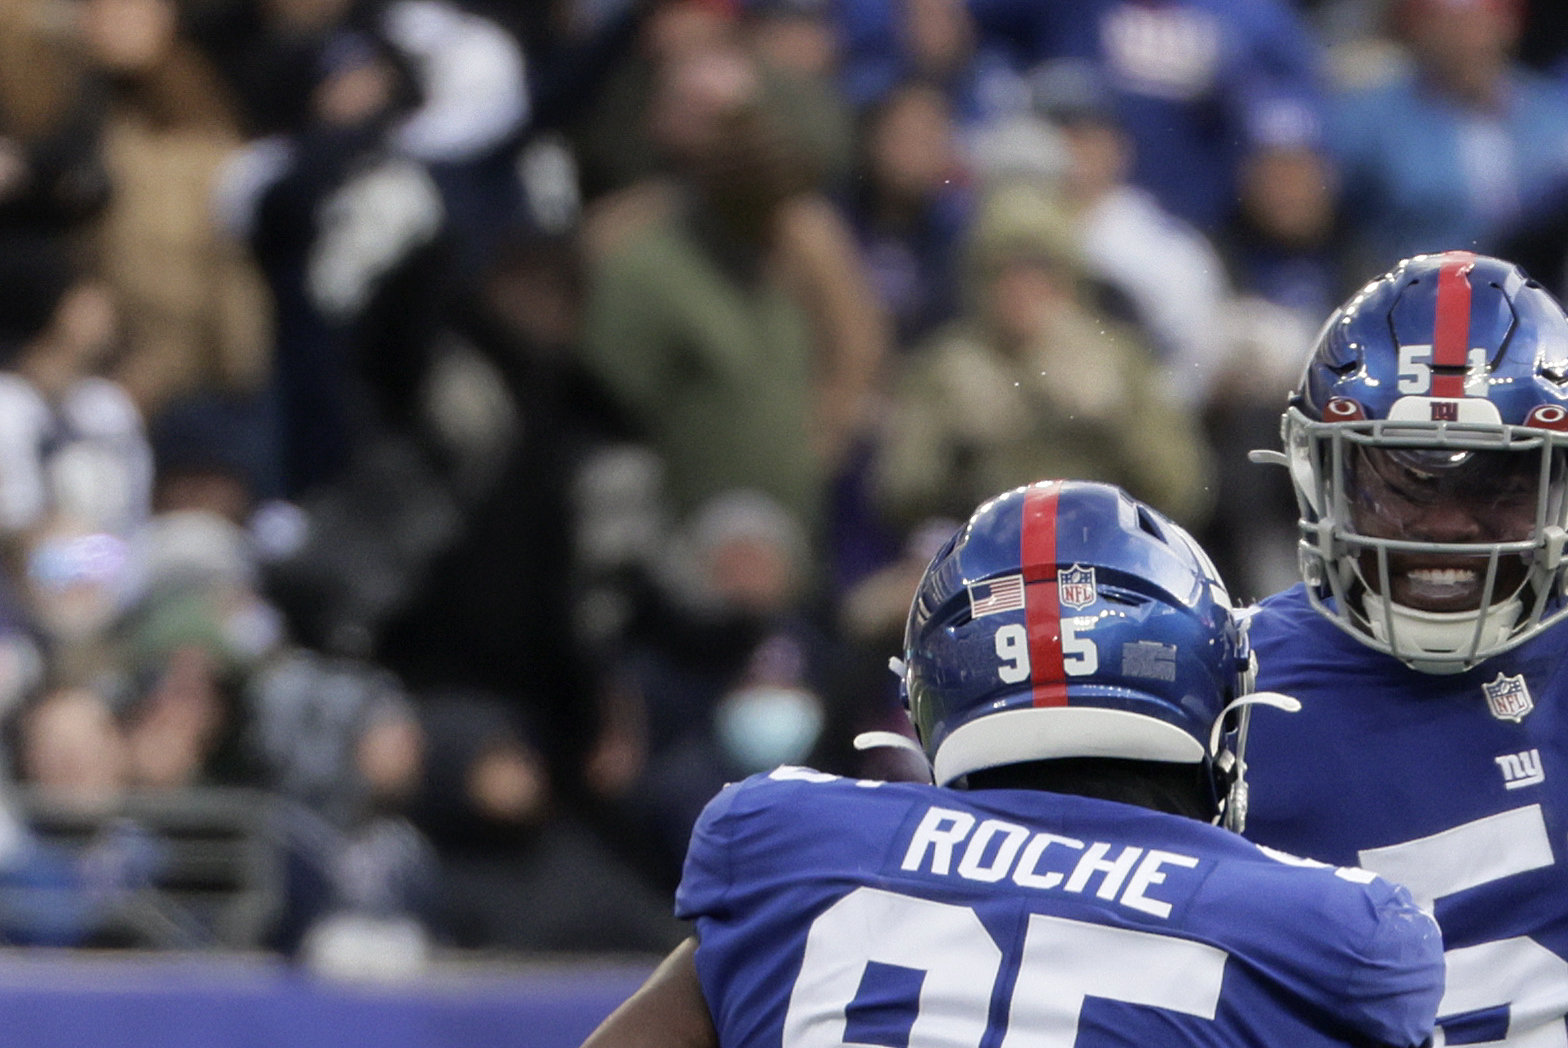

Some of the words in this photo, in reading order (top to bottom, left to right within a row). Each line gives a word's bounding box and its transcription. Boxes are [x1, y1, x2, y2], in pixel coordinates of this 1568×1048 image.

[1398, 344, 1489, 397] 51
[1065, 586, 1091, 602] NFL
[995, 617, 1098, 684] 95
[1496, 694, 1525, 713] NFL
[1495, 749, 1545, 790] ny
[901, 806, 1199, 918] ROCHE
